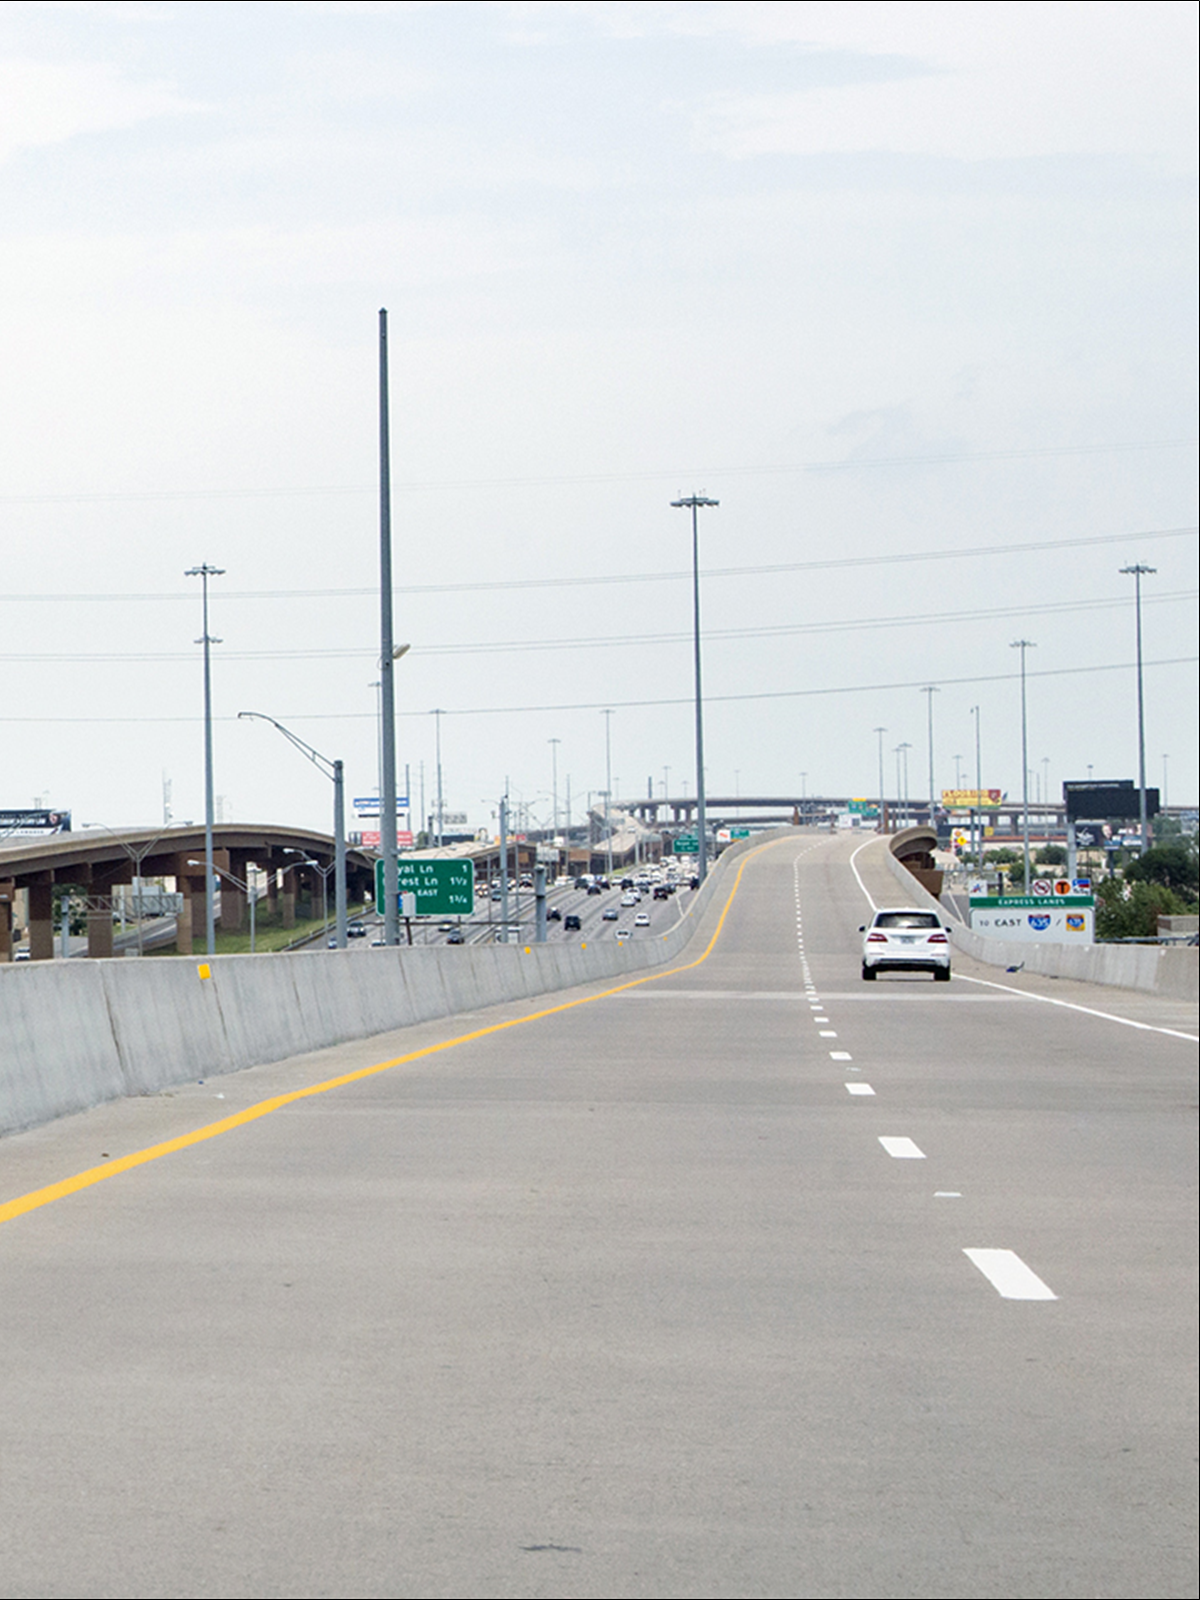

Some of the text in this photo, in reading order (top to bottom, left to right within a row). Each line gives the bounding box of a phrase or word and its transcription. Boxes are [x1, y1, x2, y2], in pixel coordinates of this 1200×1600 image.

[420, 865, 434, 873] Ln
[462, 864, 468, 873] 1
[424, 877, 438, 886] Ln
[995, 919, 1021, 927] EAST
